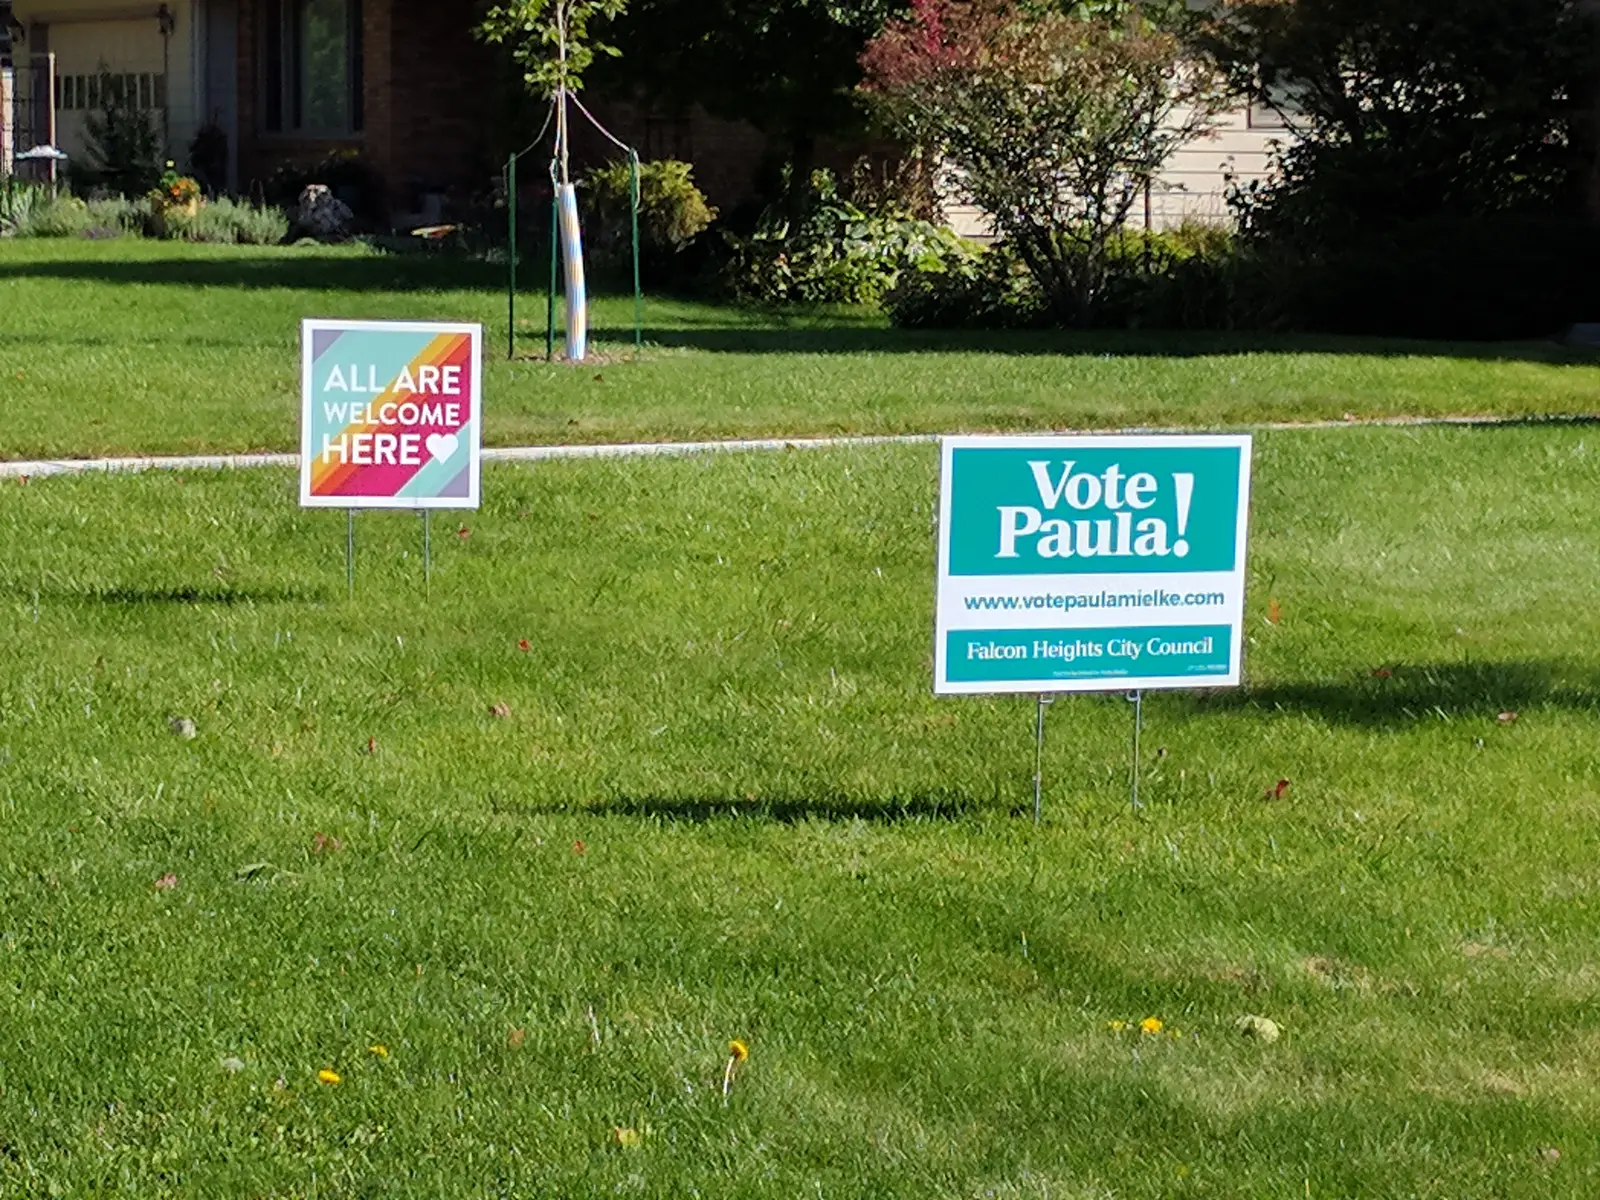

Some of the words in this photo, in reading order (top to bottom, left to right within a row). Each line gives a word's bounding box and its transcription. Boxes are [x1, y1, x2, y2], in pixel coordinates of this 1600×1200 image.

[323, 364, 386, 393] ALL
[392, 365, 461, 394] ARE
[323, 402, 460, 426] WELCOME
[322, 433, 421, 465] HERE
[1027, 460, 1158, 510] Vote
[994, 472, 1194, 559] Paula!
[964, 589, 1225, 612] www.votepaulamielke.com
[967, 641, 1027, 660] Falcon
[1033, 639, 1103, 661] Heights
[1106, 638, 1143, 660] City
[1146, 636, 1214, 656] Council
